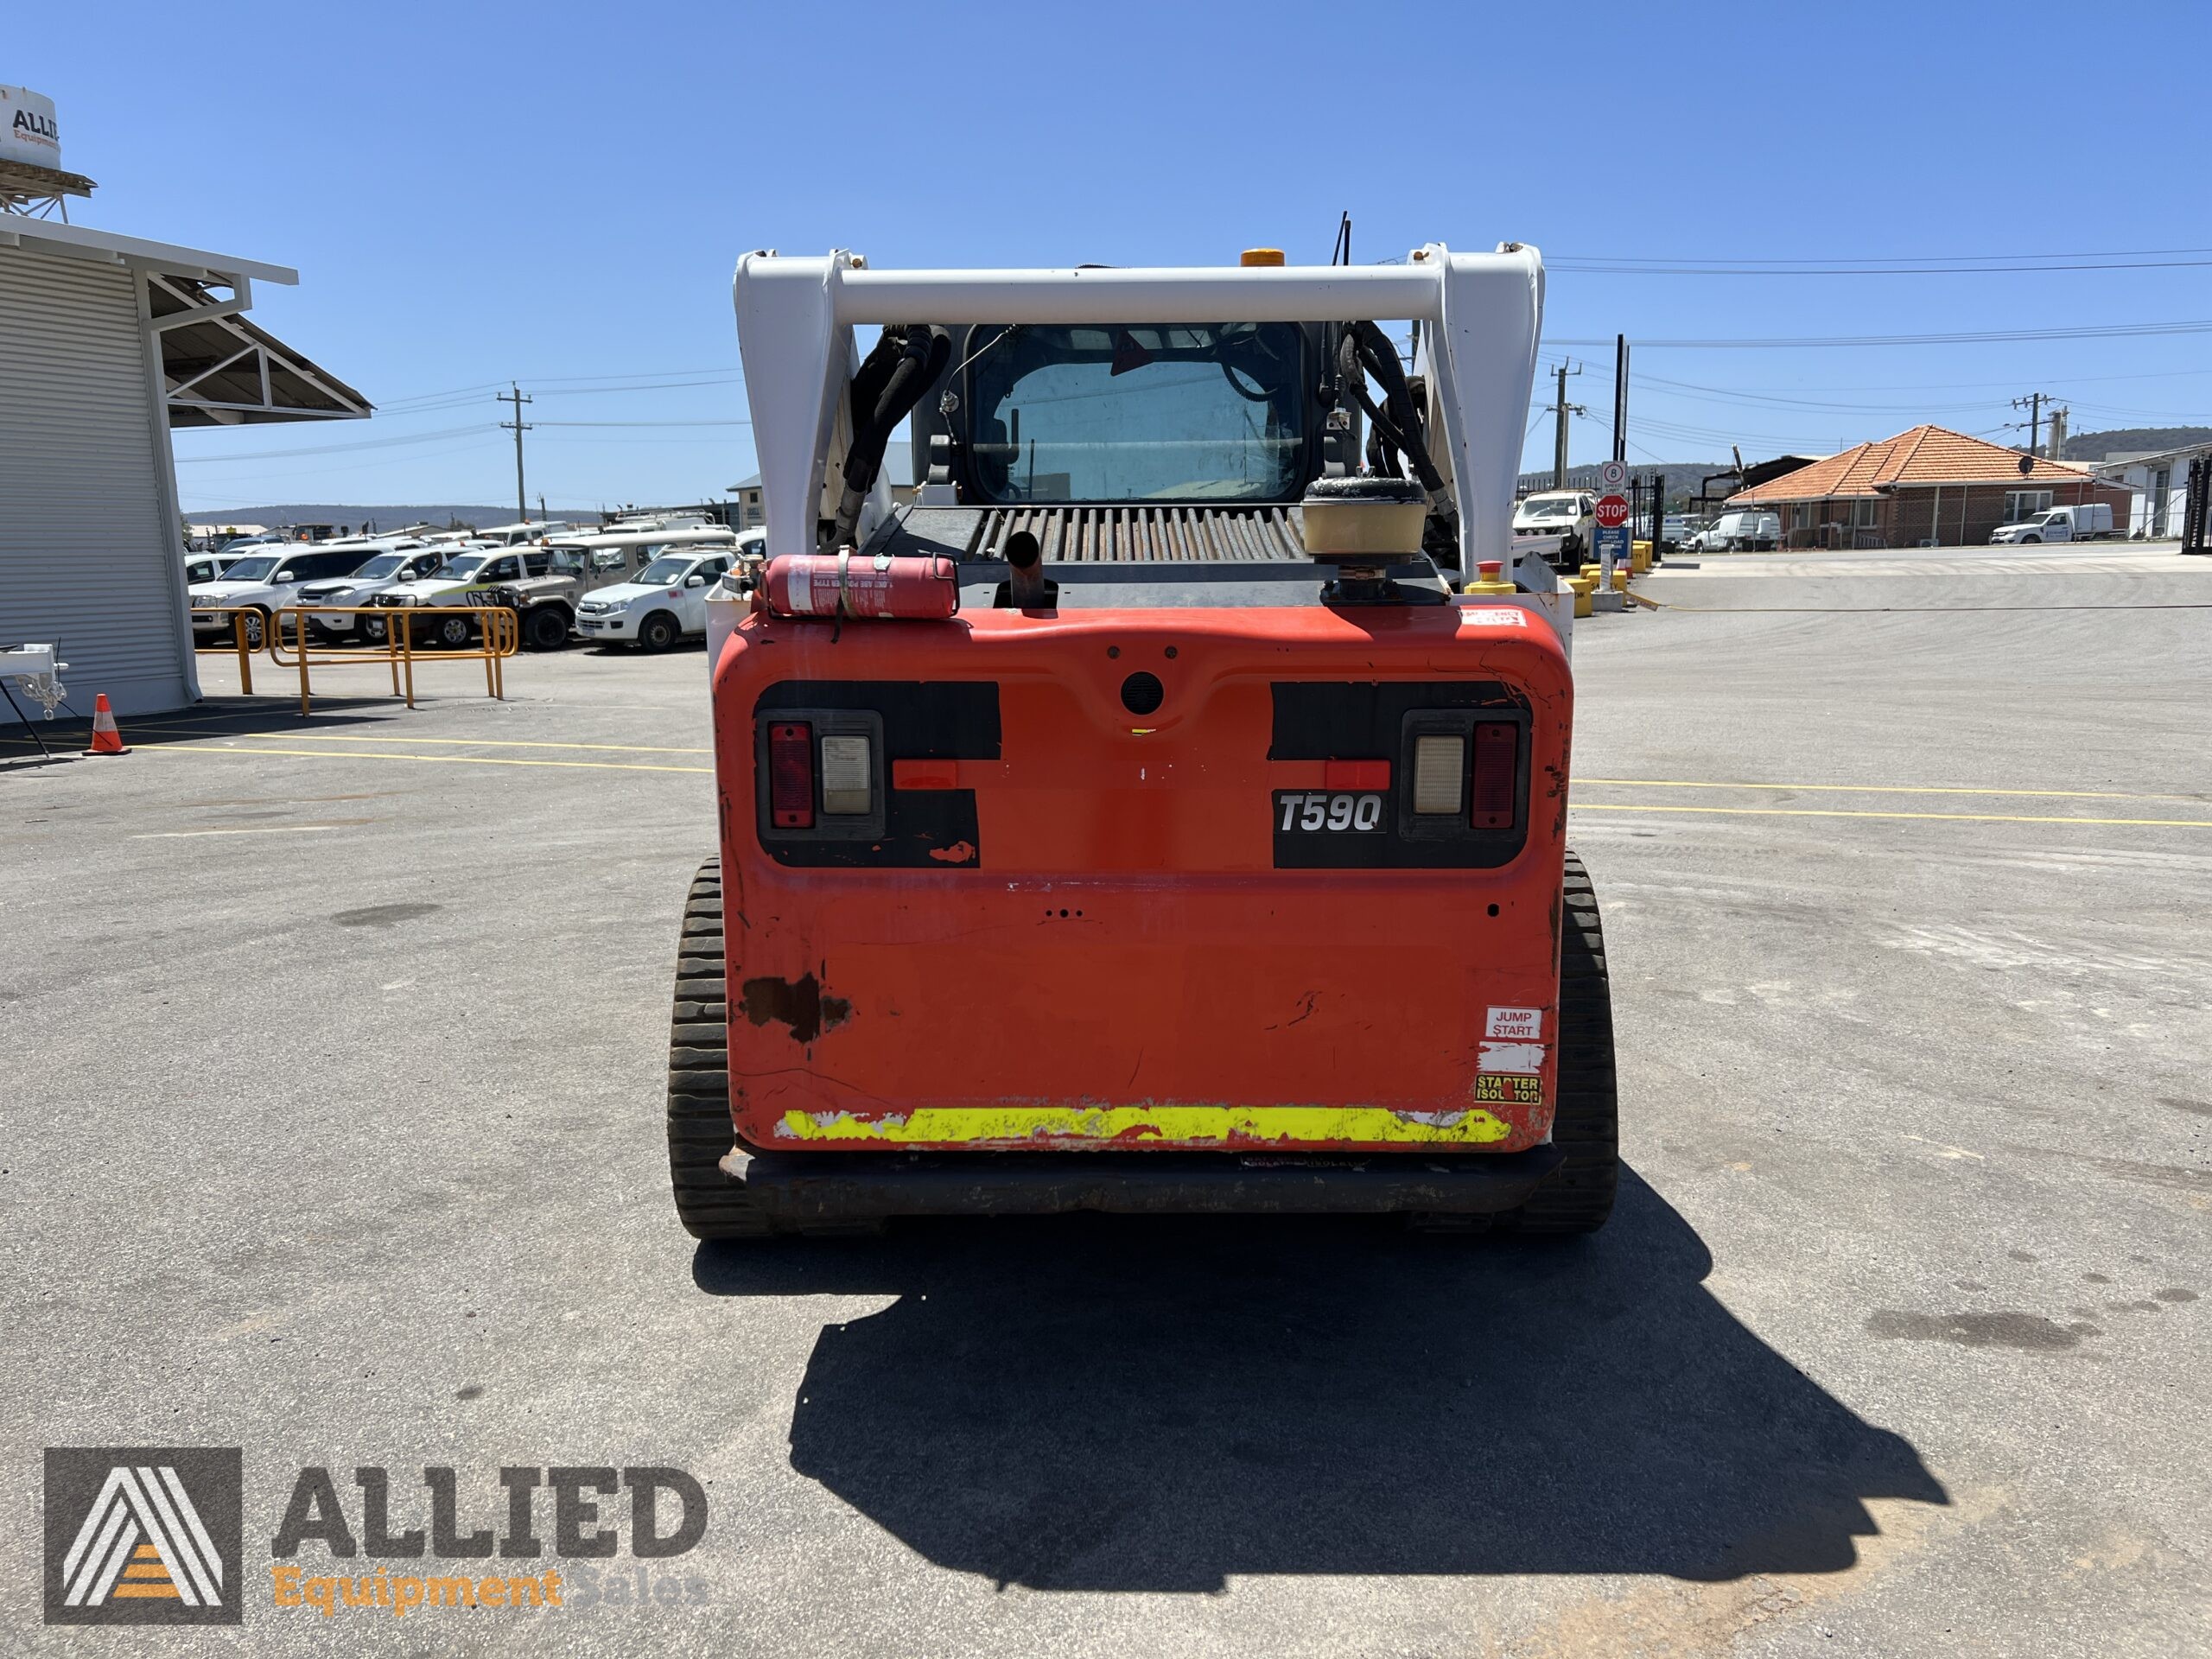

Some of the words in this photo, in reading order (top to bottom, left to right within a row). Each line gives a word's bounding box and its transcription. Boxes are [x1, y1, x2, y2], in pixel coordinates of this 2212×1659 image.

[1611, 468, 1617, 478] 8
[1597, 505, 1627, 518] STOP
[1280, 794, 1382, 831] T590
[1496, 1012, 1532, 1022] JUMP
[1493, 1025, 1534, 1035] START
